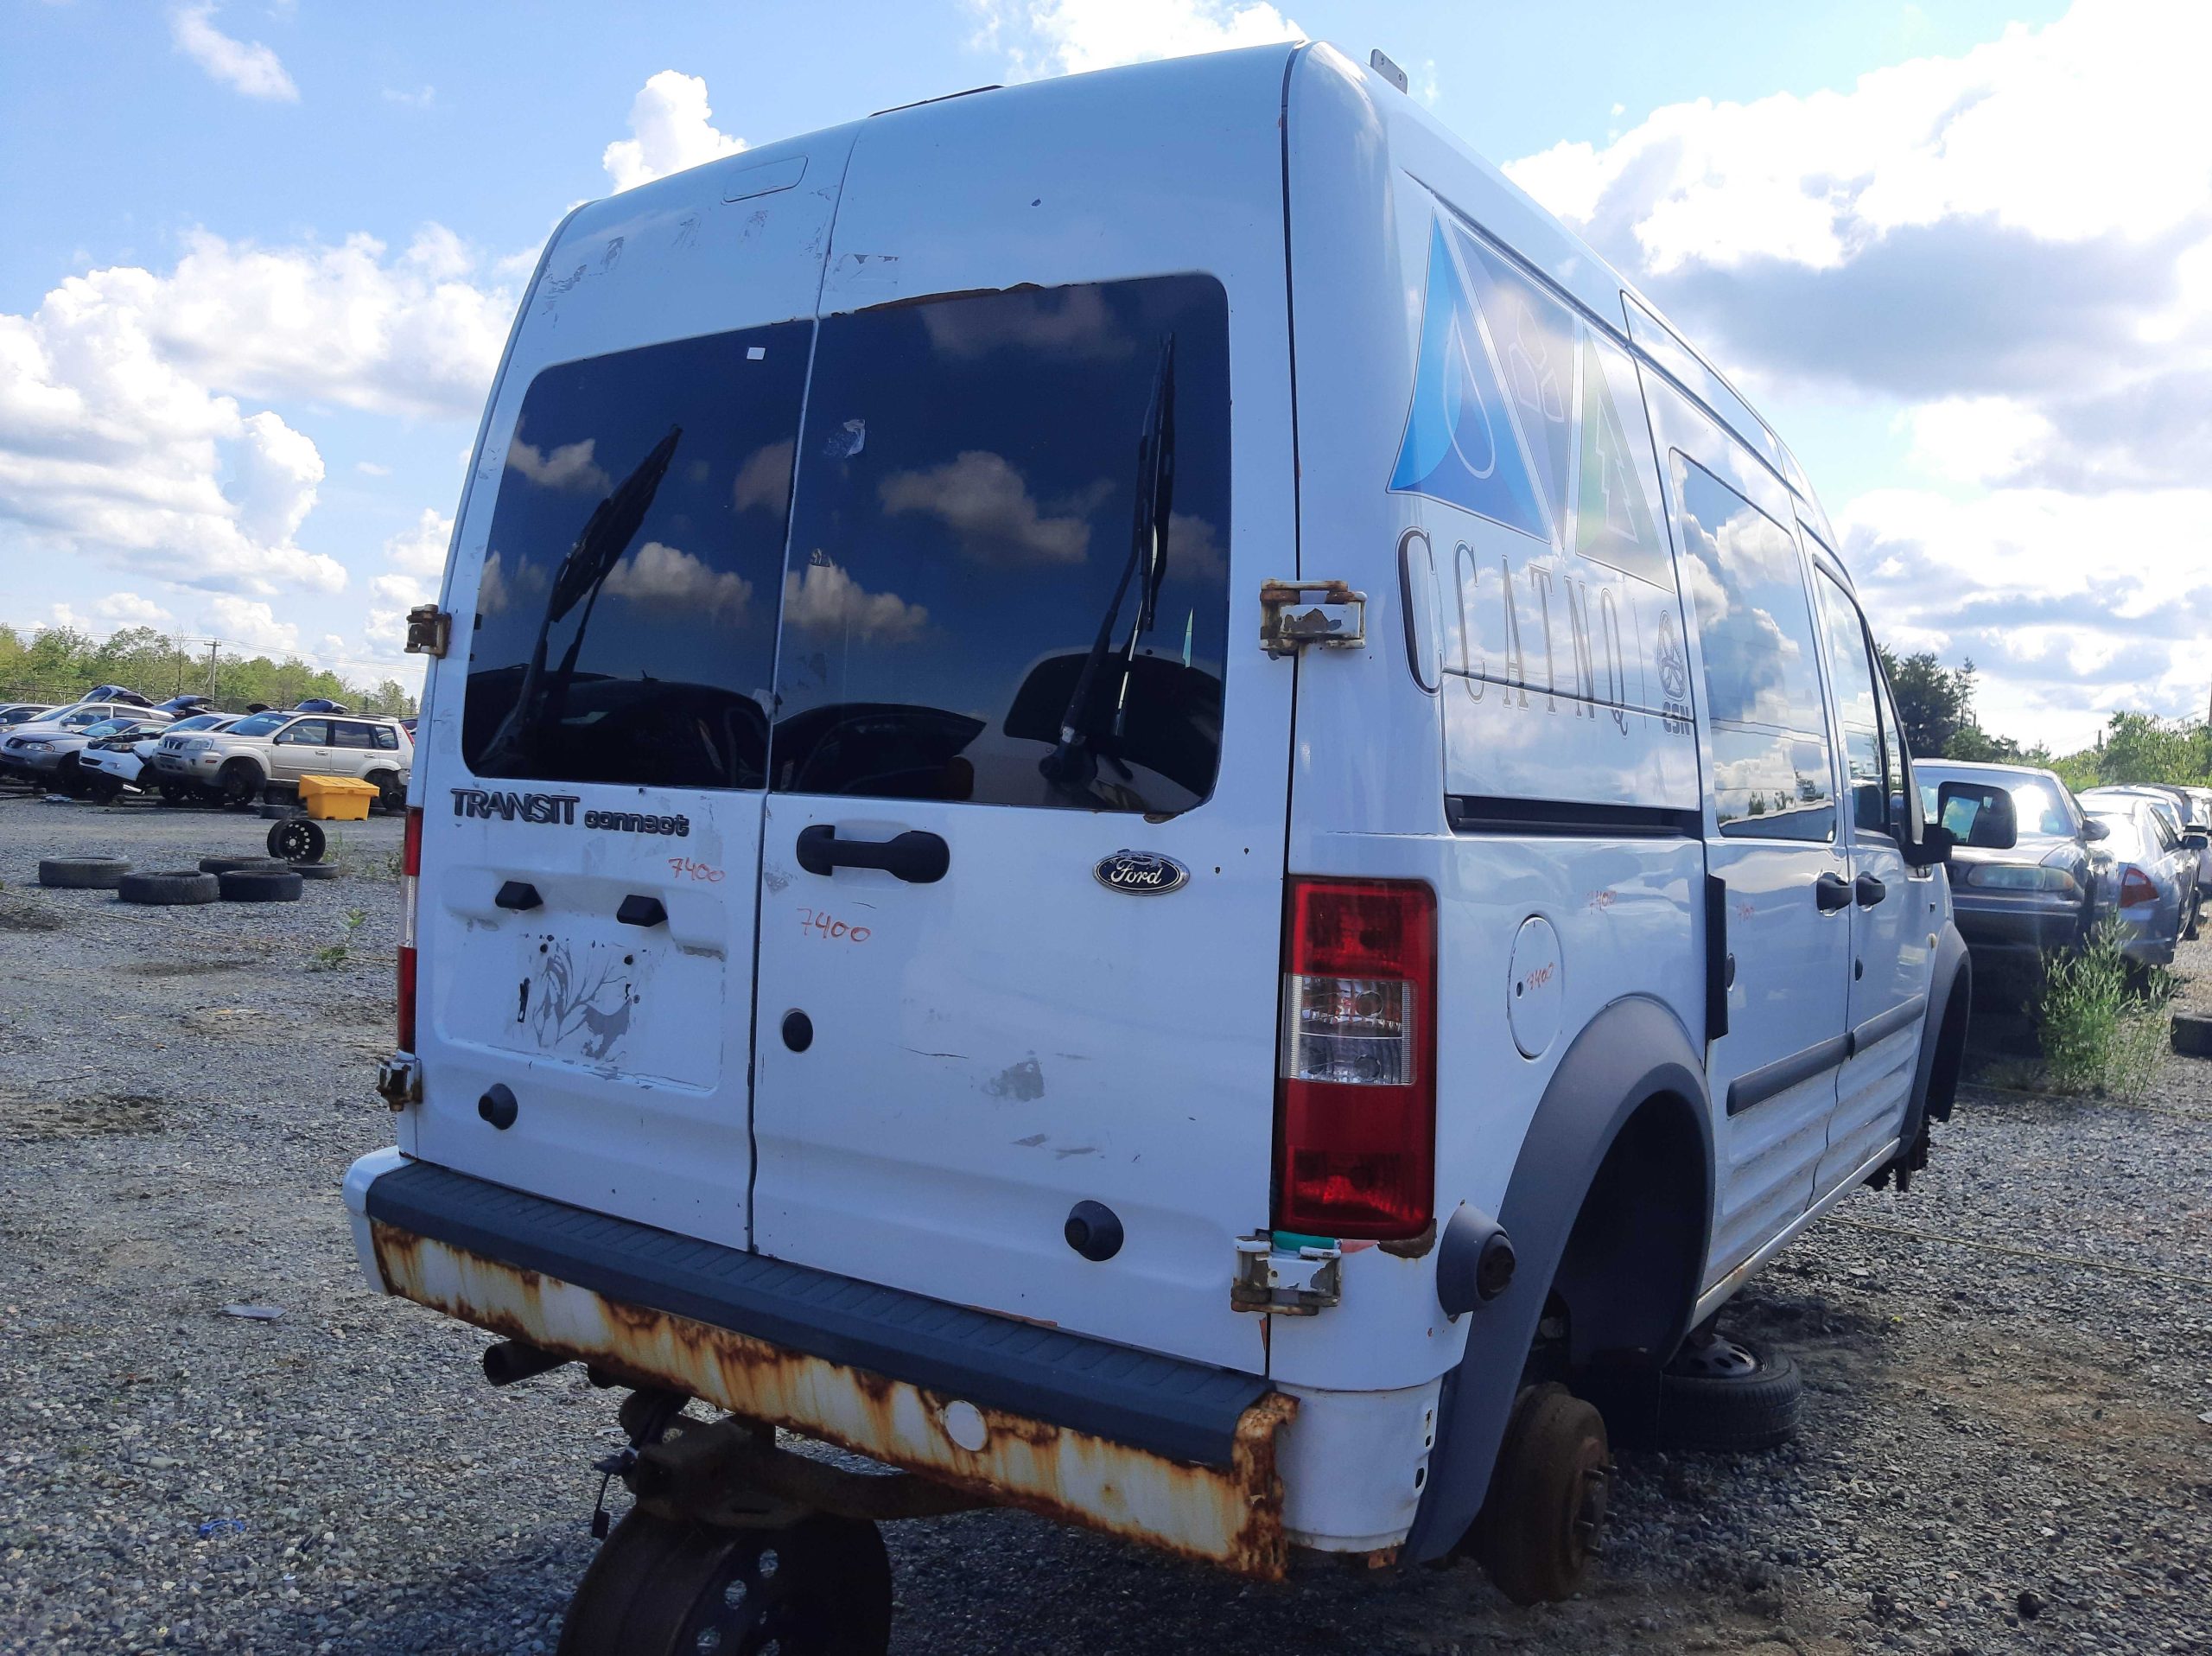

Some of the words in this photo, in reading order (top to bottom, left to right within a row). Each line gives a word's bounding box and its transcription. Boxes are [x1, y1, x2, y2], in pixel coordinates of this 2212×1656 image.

[1662, 701, 1691, 736] CSN
[450, 787, 581, 825] TRANSIT
[584, 809, 690, 838] connect
[668, 858, 726, 882] 7400
[1110, 857, 1164, 886] Ford
[797, 907, 872, 943] 7400
